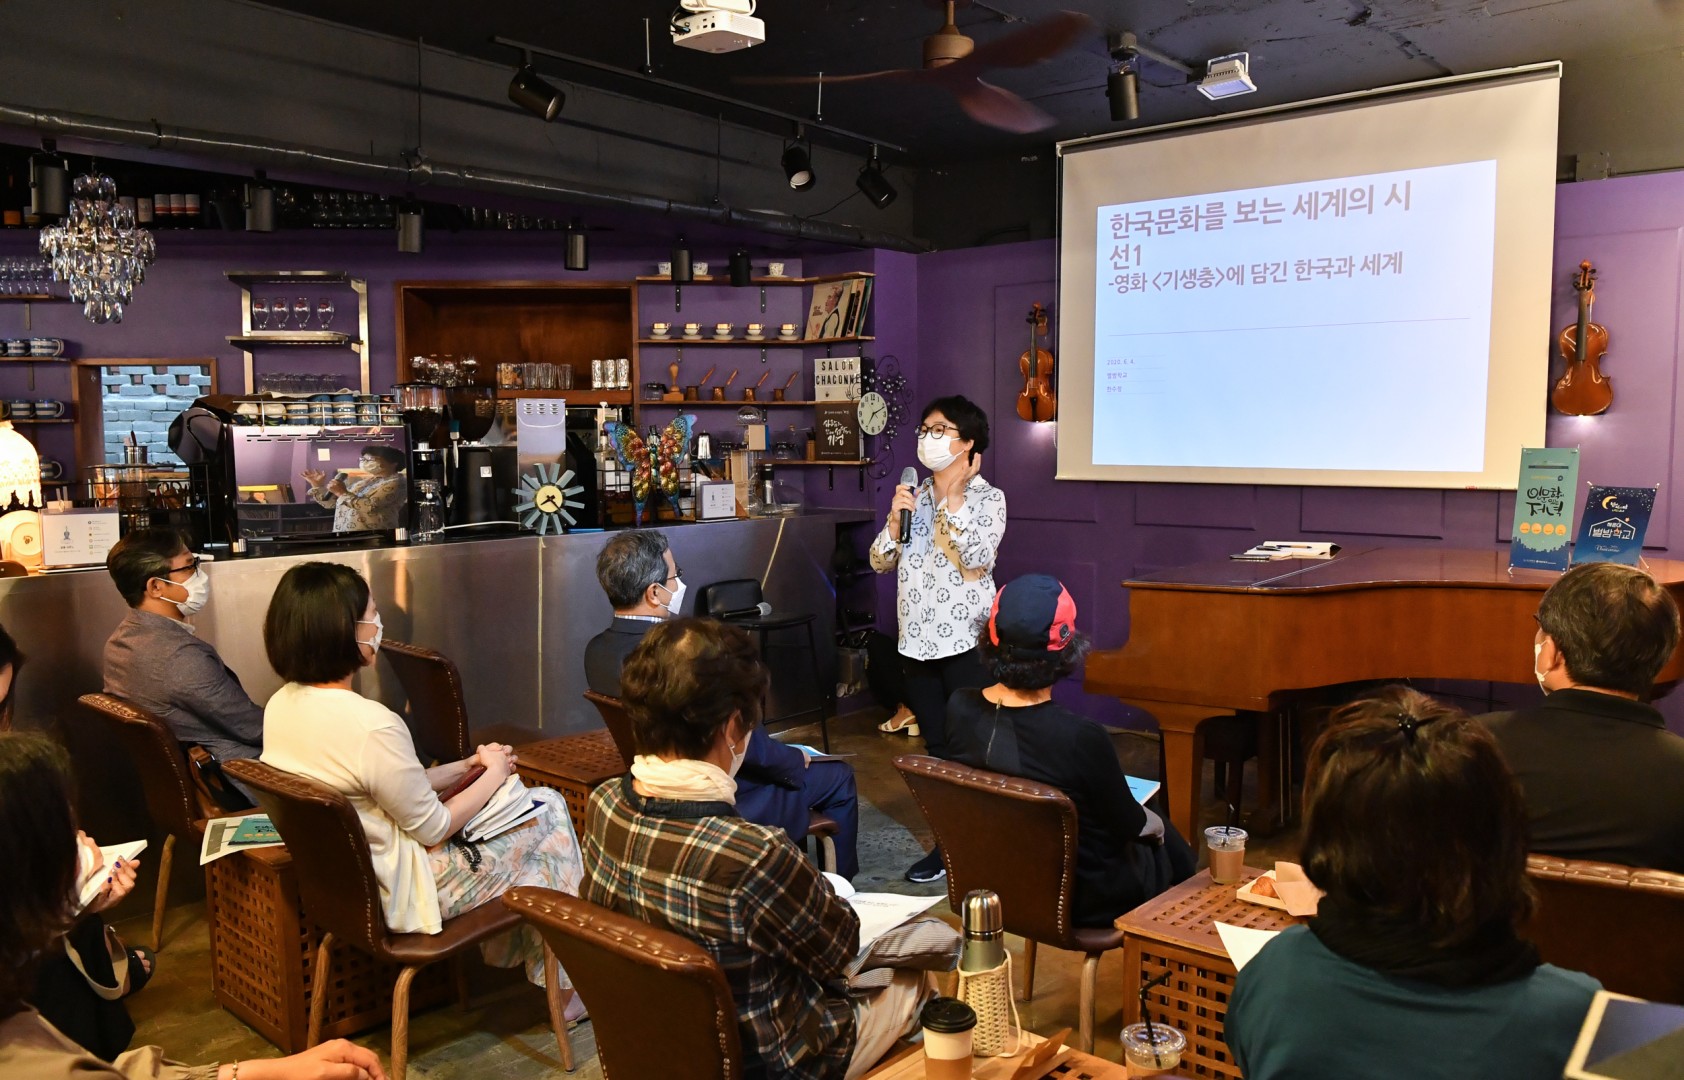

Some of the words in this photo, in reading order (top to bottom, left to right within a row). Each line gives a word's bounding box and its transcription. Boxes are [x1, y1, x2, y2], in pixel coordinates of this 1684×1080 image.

[1110, 201, 1227, 239] 한국문화를
[1233, 197, 1286, 225] 보는
[1292, 184, 1375, 220] 세계의
[1384, 180, 1411, 211] 시
[1109, 244, 1142, 270] 선1
[1108, 272, 1147, 294] -영화
[1152, 265, 1245, 292] <기생충>에
[1251, 262, 1287, 285] 담긴
[1294, 256, 1355, 281] 한국과
[1360, 251, 1403, 276] 세계
[822, 361, 854, 371] SALON
[816, 374, 861, 385] CHACONNE
[1526, 501, 1563, 516] 저녁
